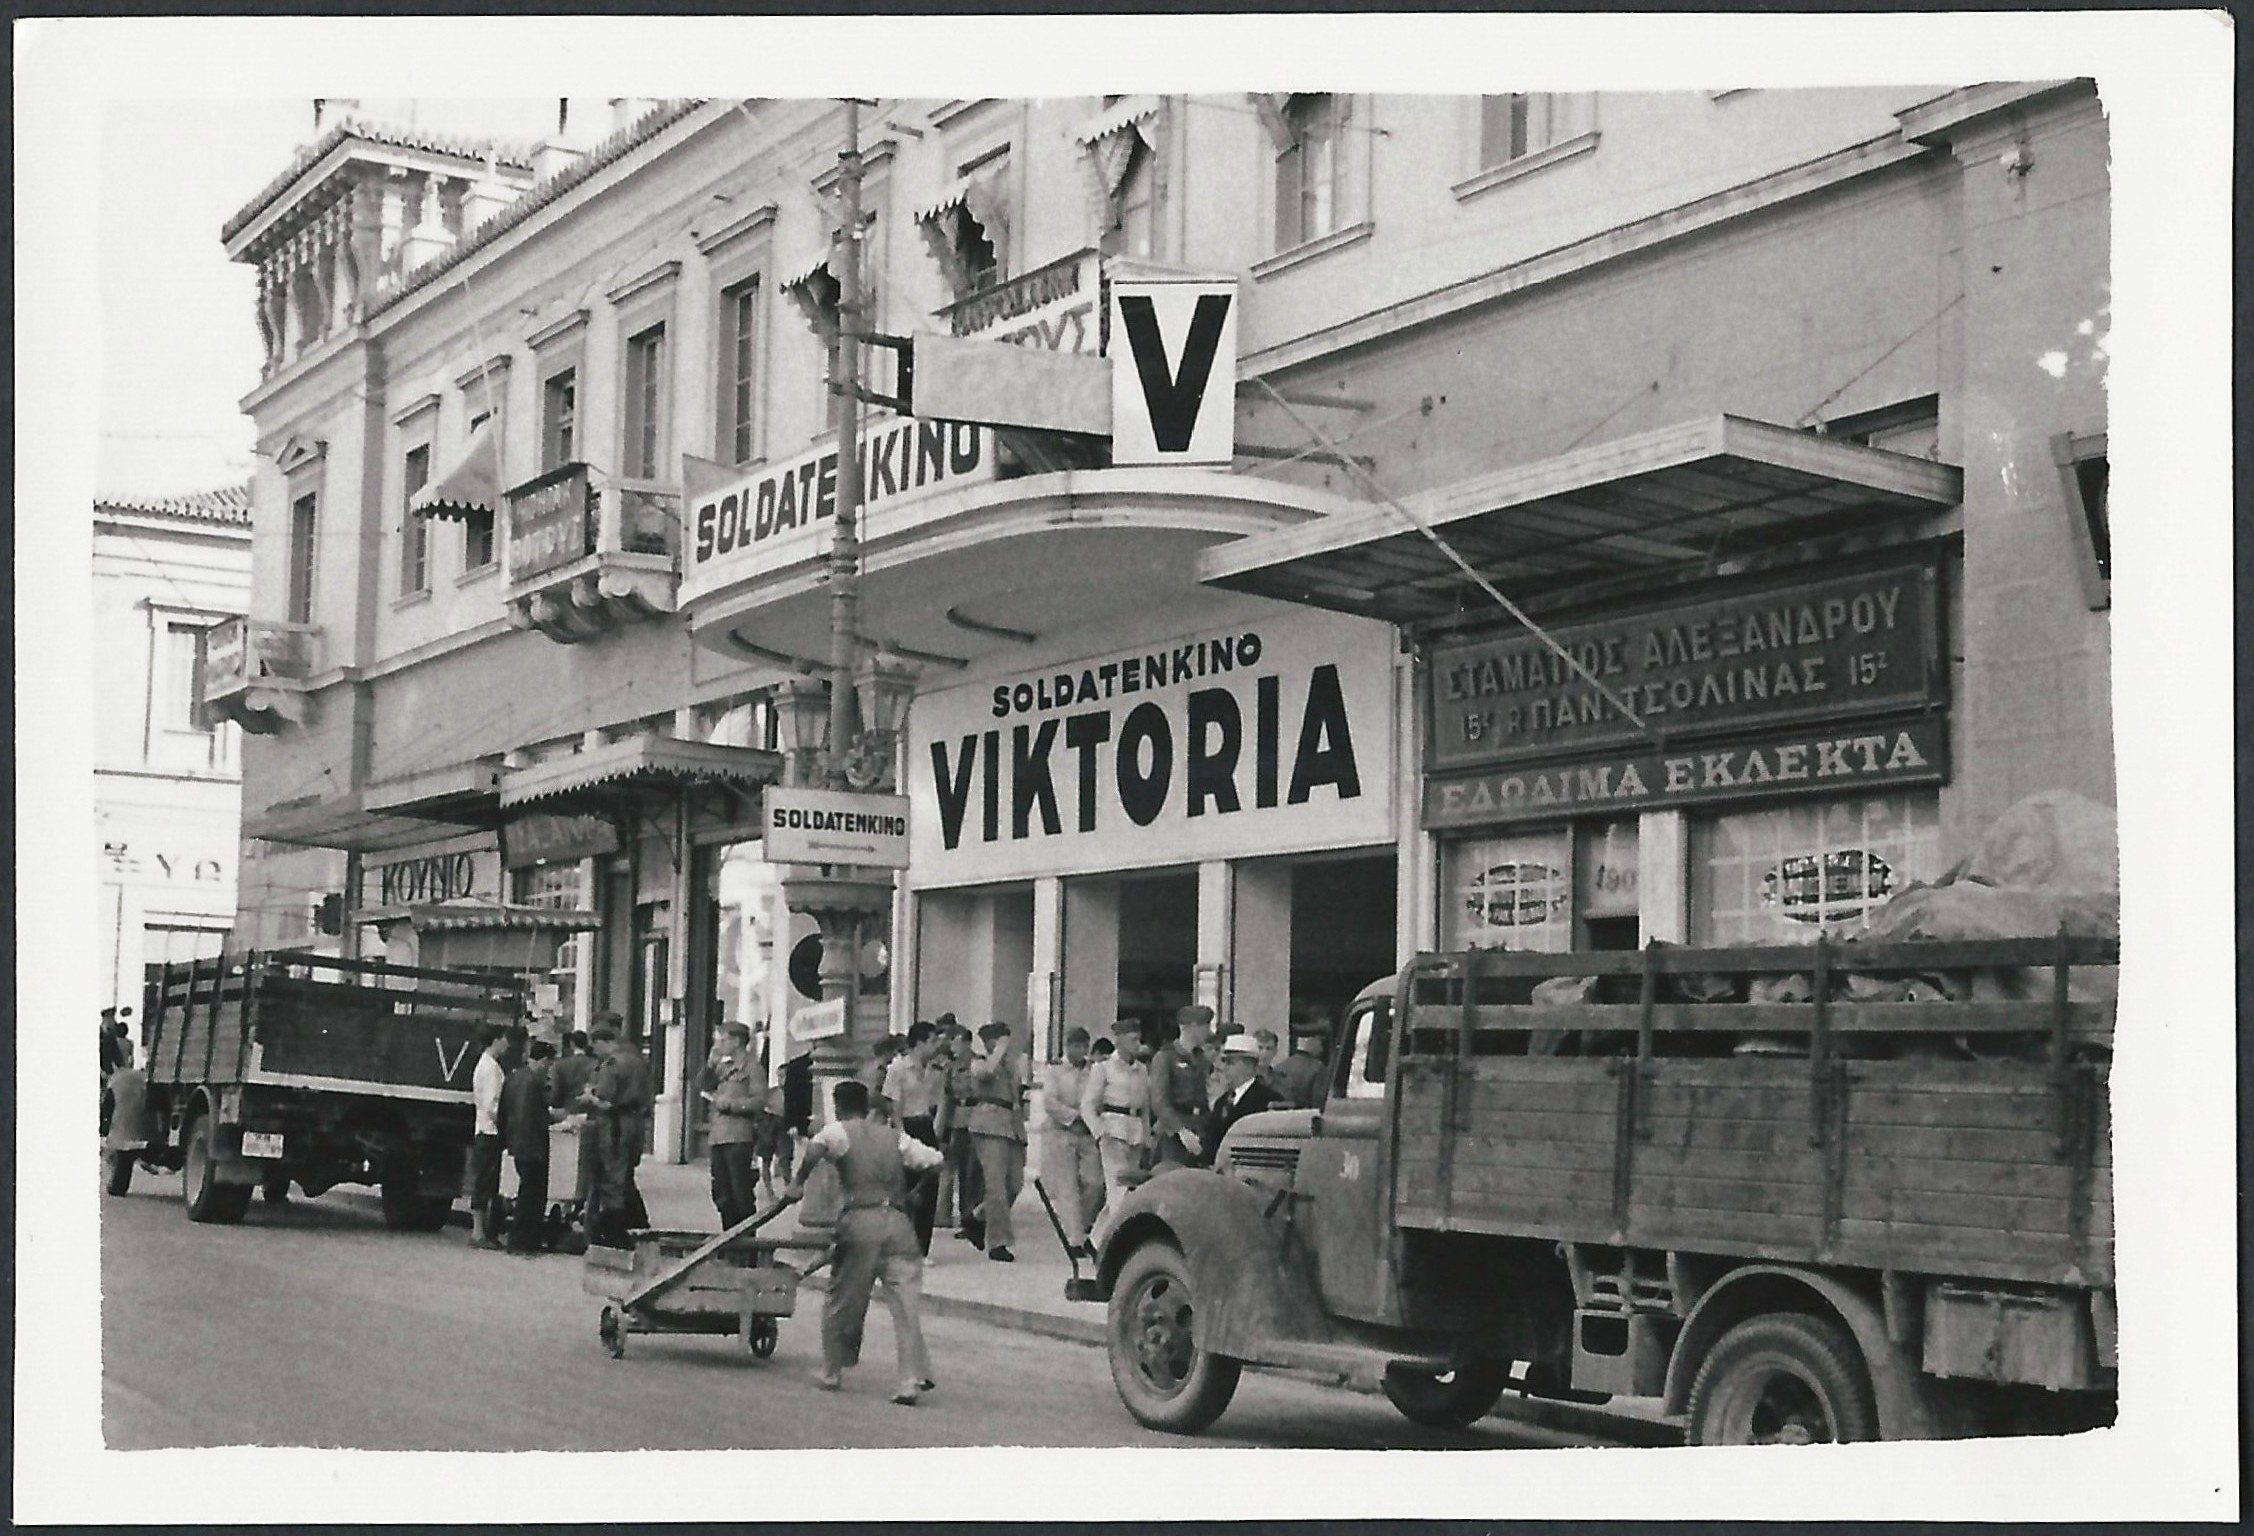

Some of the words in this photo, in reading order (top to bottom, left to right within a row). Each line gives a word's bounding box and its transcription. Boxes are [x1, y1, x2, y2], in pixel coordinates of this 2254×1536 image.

[1118, 294, 1233, 453] V
[696, 421, 981, 564] SOLDATEKINO
[1643, 586, 1900, 669] ΑΛΕΞΑΝΔΡΟΥ
[993, 632, 1262, 718] SOLDATENKINO
[930, 663, 1359, 852] VIKTORIA
[1664, 731, 1928, 793] ΕΚΛΕΚΤΑ
[773, 807, 906, 837] SOLDATENKINO
[434, 1036, 470, 1083] V
